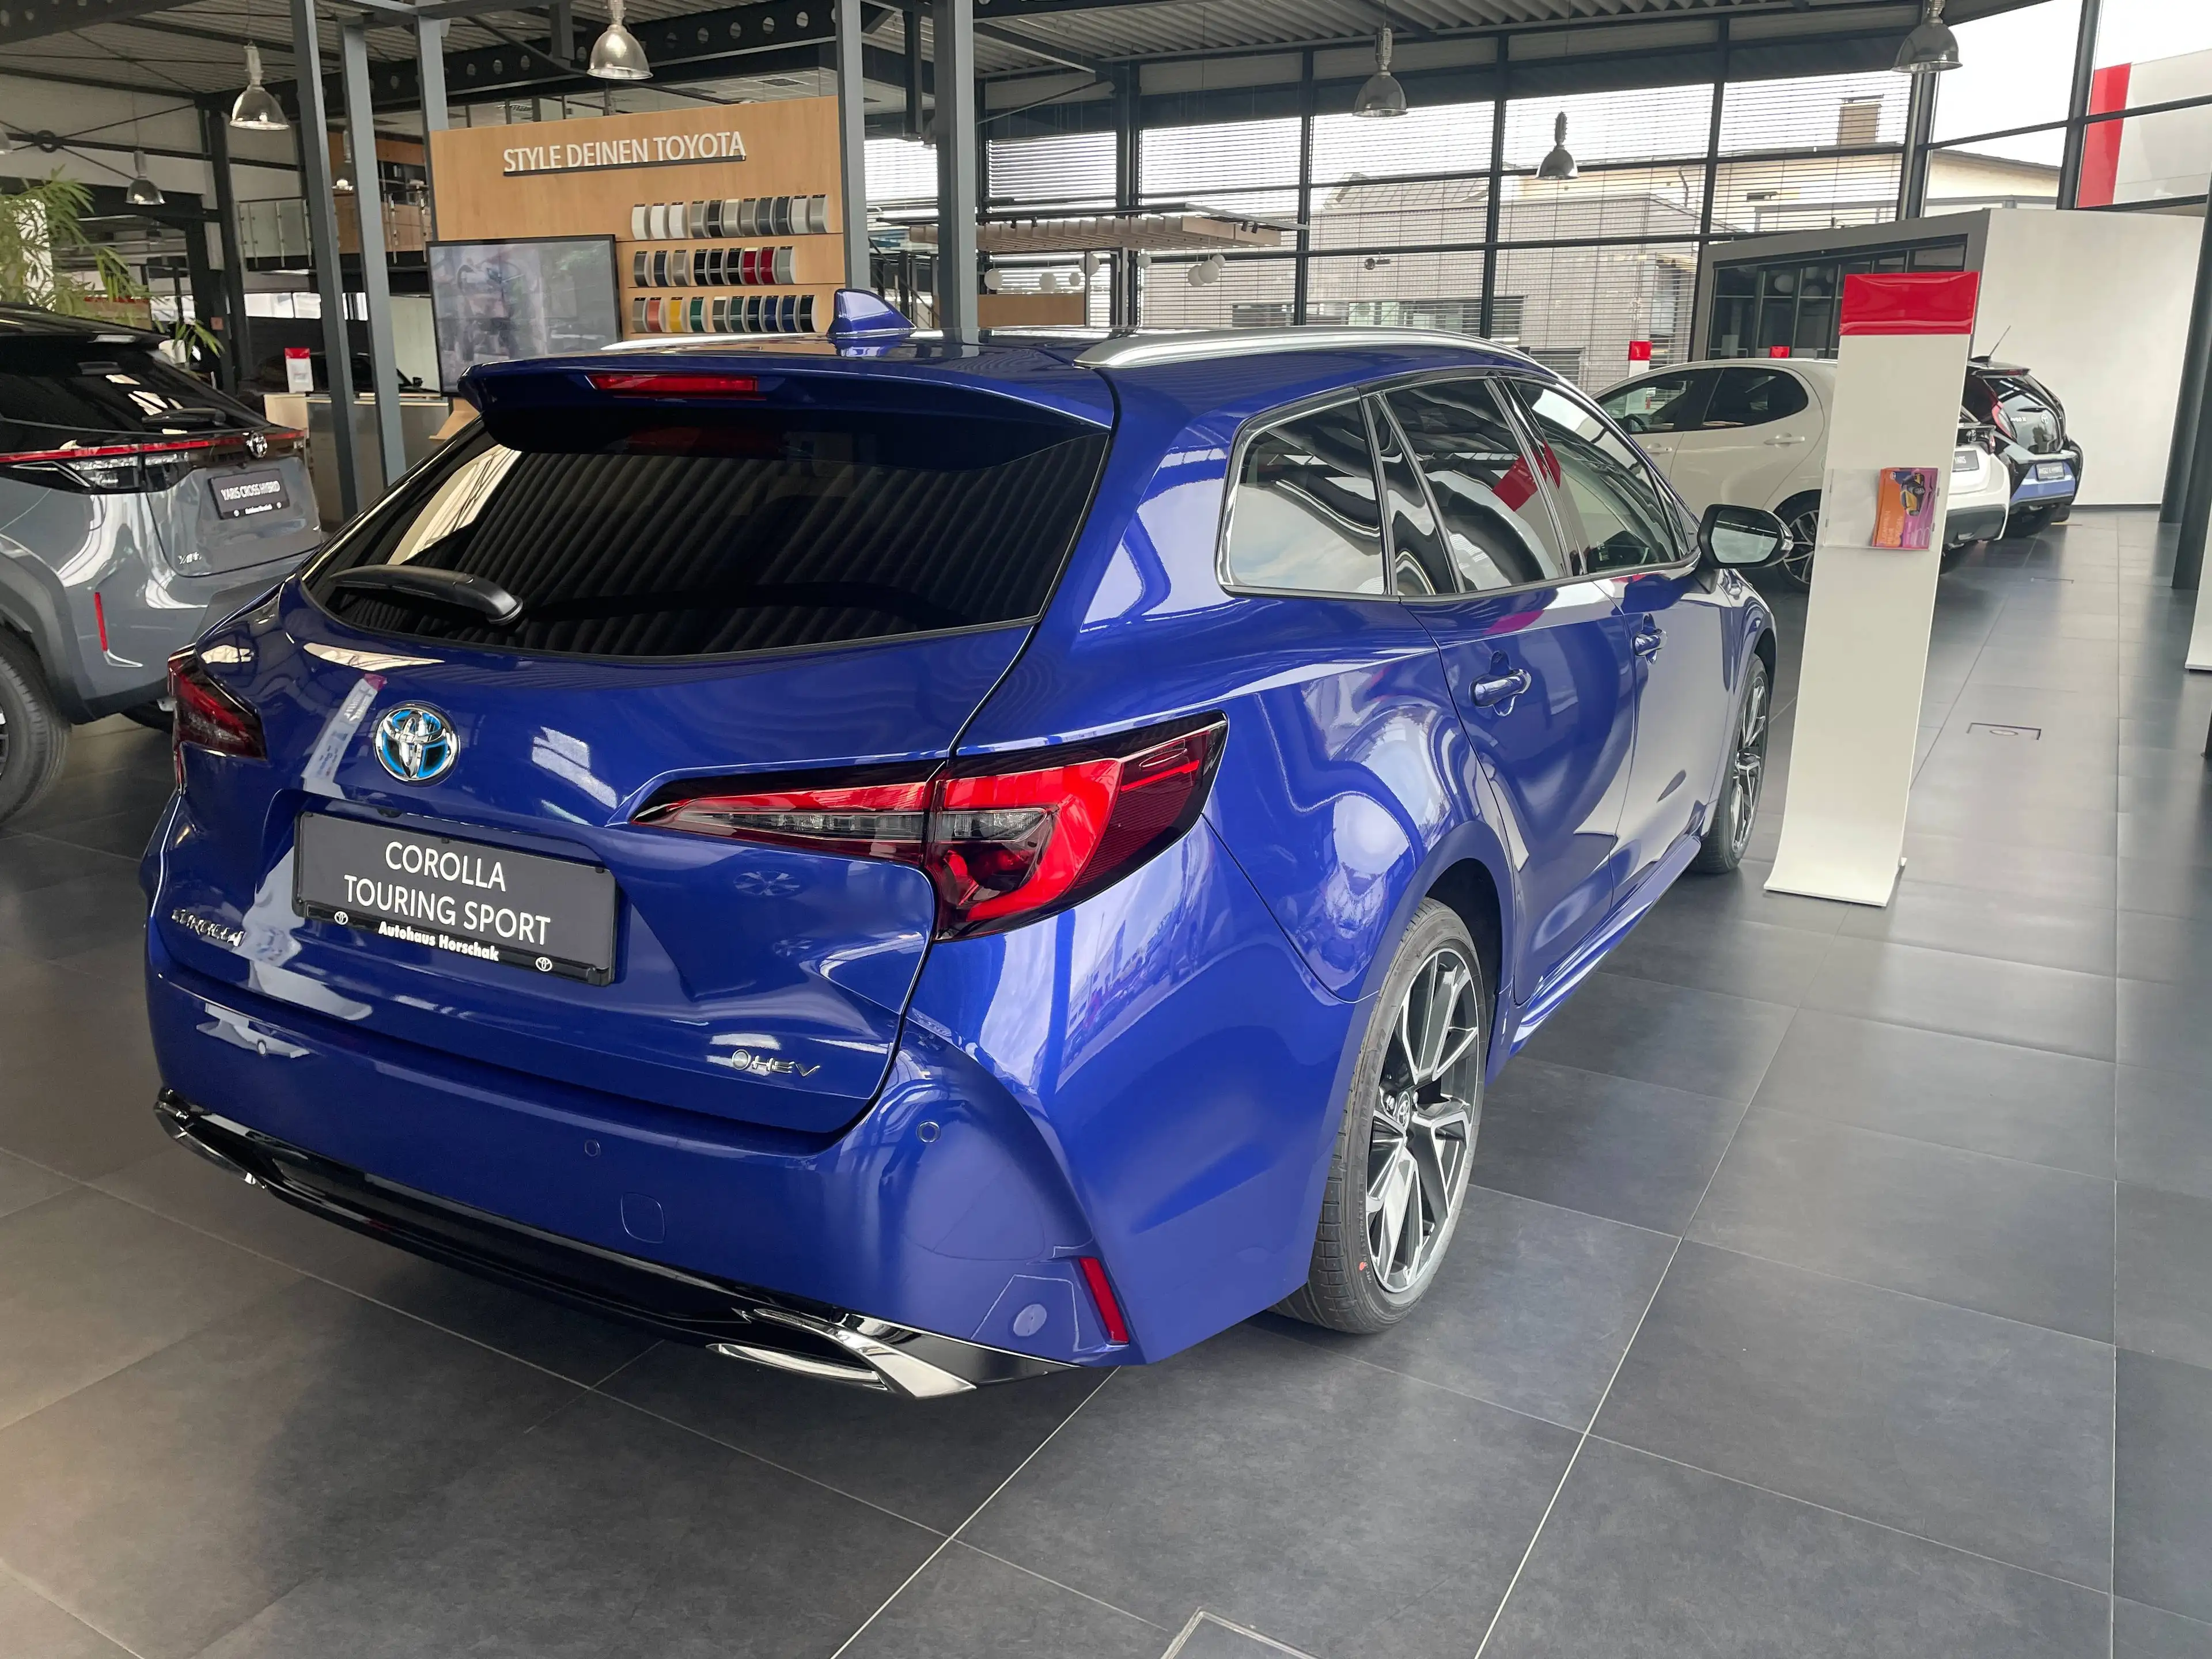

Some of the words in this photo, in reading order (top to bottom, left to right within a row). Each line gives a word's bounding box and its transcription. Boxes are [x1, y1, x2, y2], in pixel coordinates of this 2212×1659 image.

[503, 145, 562, 172] STYLE
[566, 138, 648, 168] DEINEN
[653, 131, 745, 161] TOYOTA
[385, 841, 506, 892] COROLLA
[344, 874, 456, 926] TOURING
[463, 900, 551, 945] SPORT
[378, 921, 436, 947] Autohaus
[438, 934, 499, 962] Horschak
